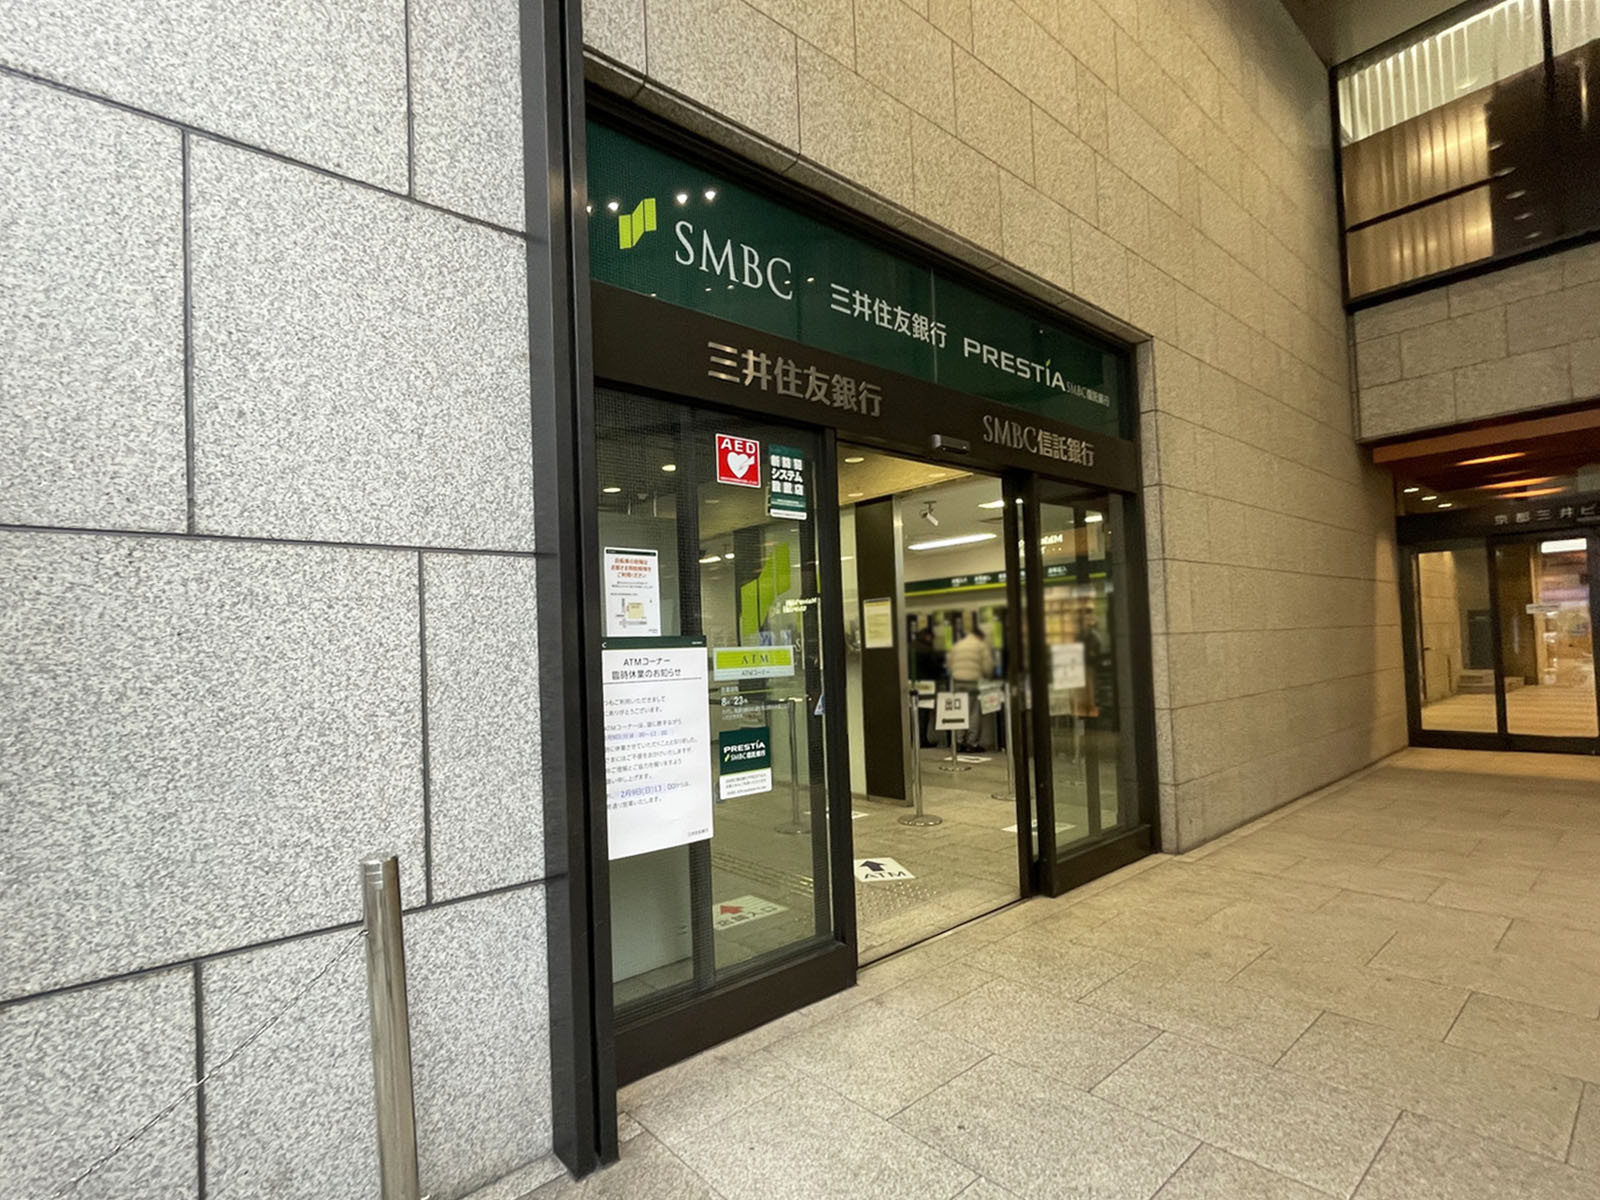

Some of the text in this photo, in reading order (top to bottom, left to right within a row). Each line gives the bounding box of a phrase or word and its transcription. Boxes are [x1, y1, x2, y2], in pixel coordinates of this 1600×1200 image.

[675, 221, 793, 300] SMBC
[831, 283, 947, 348] 三井住友銀行
[708, 341, 882, 417] 三井住友銀行
[721, 438, 756, 455] AED
[983, 415, 1094, 467] SMBC信託銀行
[771, 467, 804, 483] システム
[623, 656, 671, 666] ATMコーナー
[742, 654, 769, 665] ATM
[611, 668, 681, 681] 臨時休業のお知らせ
[864, 871, 906, 879] ATM
